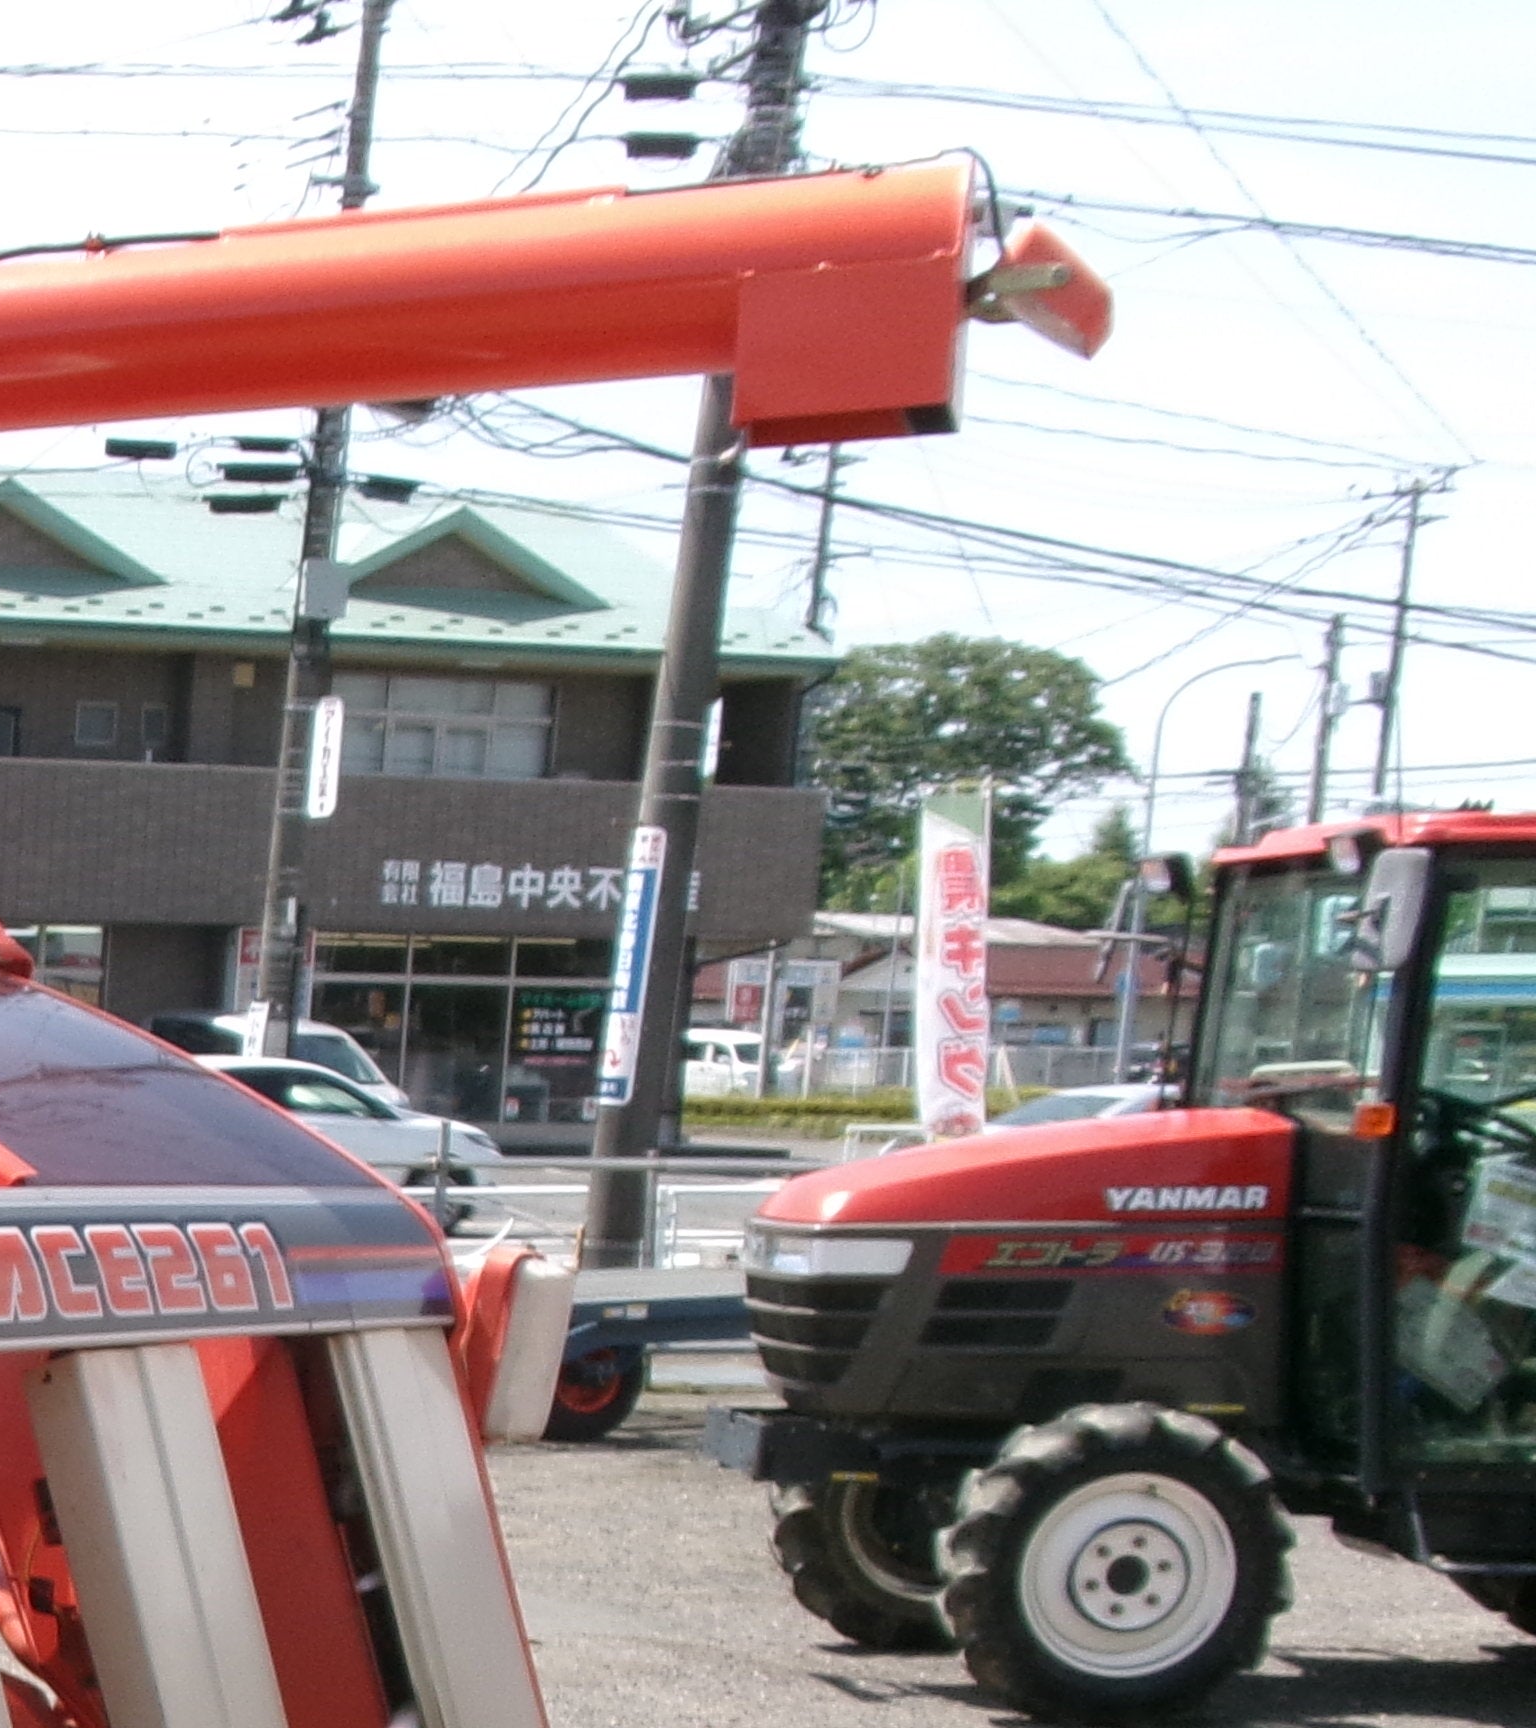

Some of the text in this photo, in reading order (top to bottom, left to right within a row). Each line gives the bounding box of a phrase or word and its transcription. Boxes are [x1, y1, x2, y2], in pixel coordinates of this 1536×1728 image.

[429, 862, 701, 910] 福島中央不
[1105, 1186, 1269, 1212] YANMAR
[986, 1241, 1124, 1267] エコトラ
